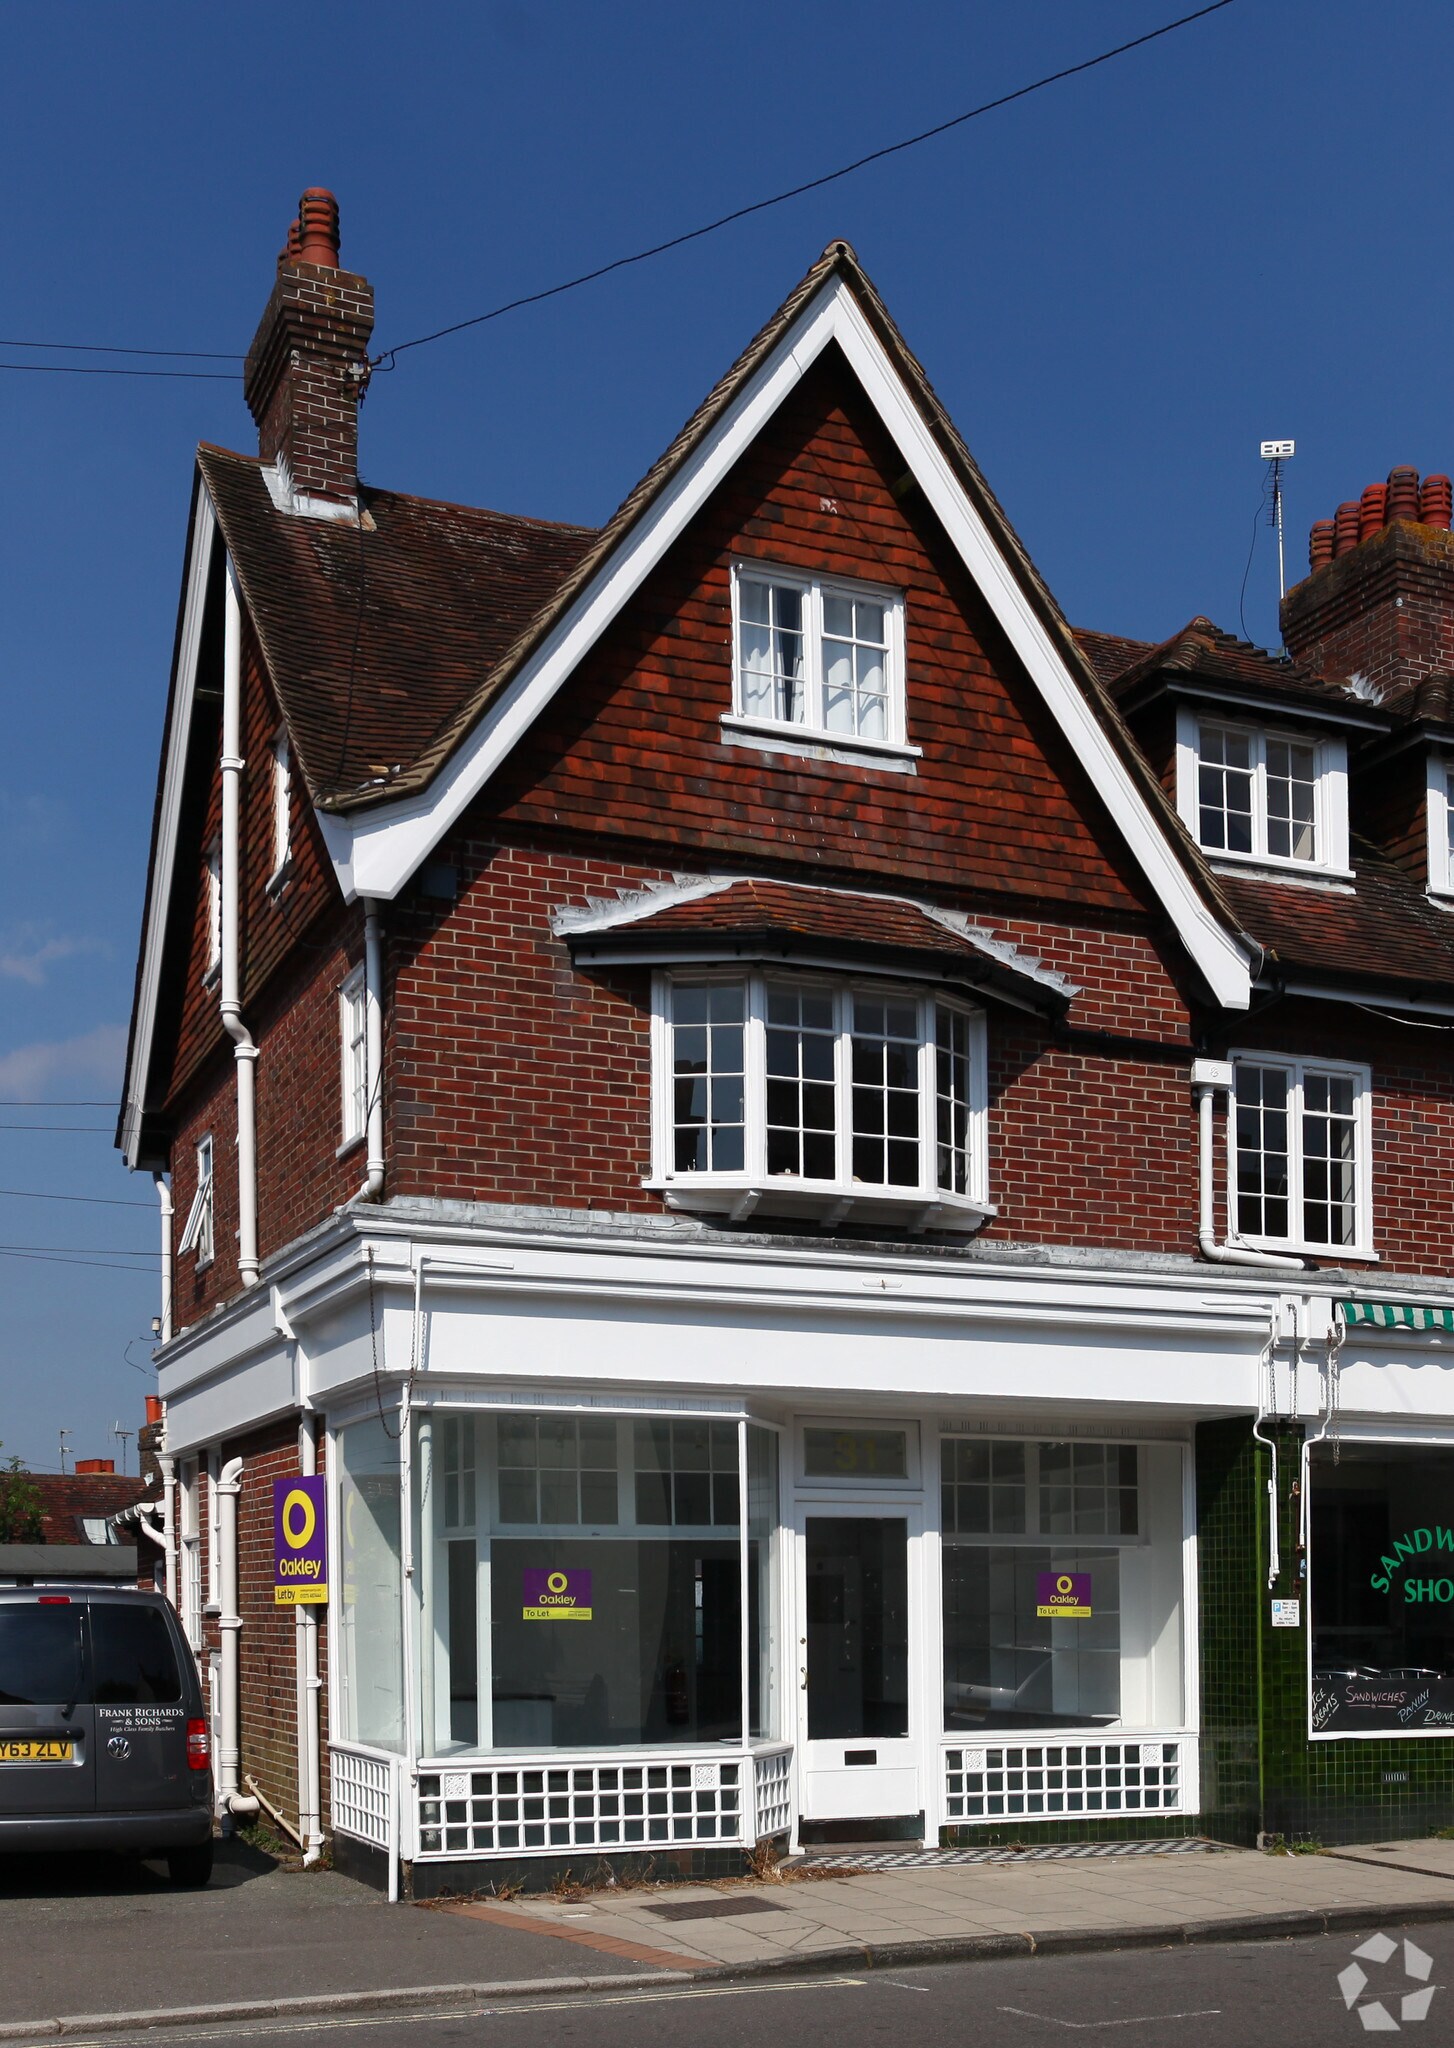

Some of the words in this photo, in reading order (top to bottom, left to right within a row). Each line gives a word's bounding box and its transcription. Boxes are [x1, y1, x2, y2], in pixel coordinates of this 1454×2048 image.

[833, 1435, 877, 1469] 31
[279, 1557, 321, 1579] Oakley
[1371, 1526, 1454, 1594] SANDW
[278, 1589, 287, 1599] Let
[287, 1588, 295, 1601] by
[539, 1594, 576, 1607] Oakley
[1049, 1594, 1079, 1606] Oakley
[1404, 1578, 1454, 1603] SHO
[1312, 1688, 1326, 1711] ICE
[1312, 1693, 1338, 1727] CREAMS
[1397, 1689, 1430, 1722] PANINI
[99, 1708, 133, 1717] FRANK
[134, 1708, 184, 1717] RICHARDS
[124, 1718, 132, 1726] &
[134, 1717, 161, 1726] SONS
[0, 1742, 31, 1757] Y63
[36, 1742, 69, 1757] ZLV
